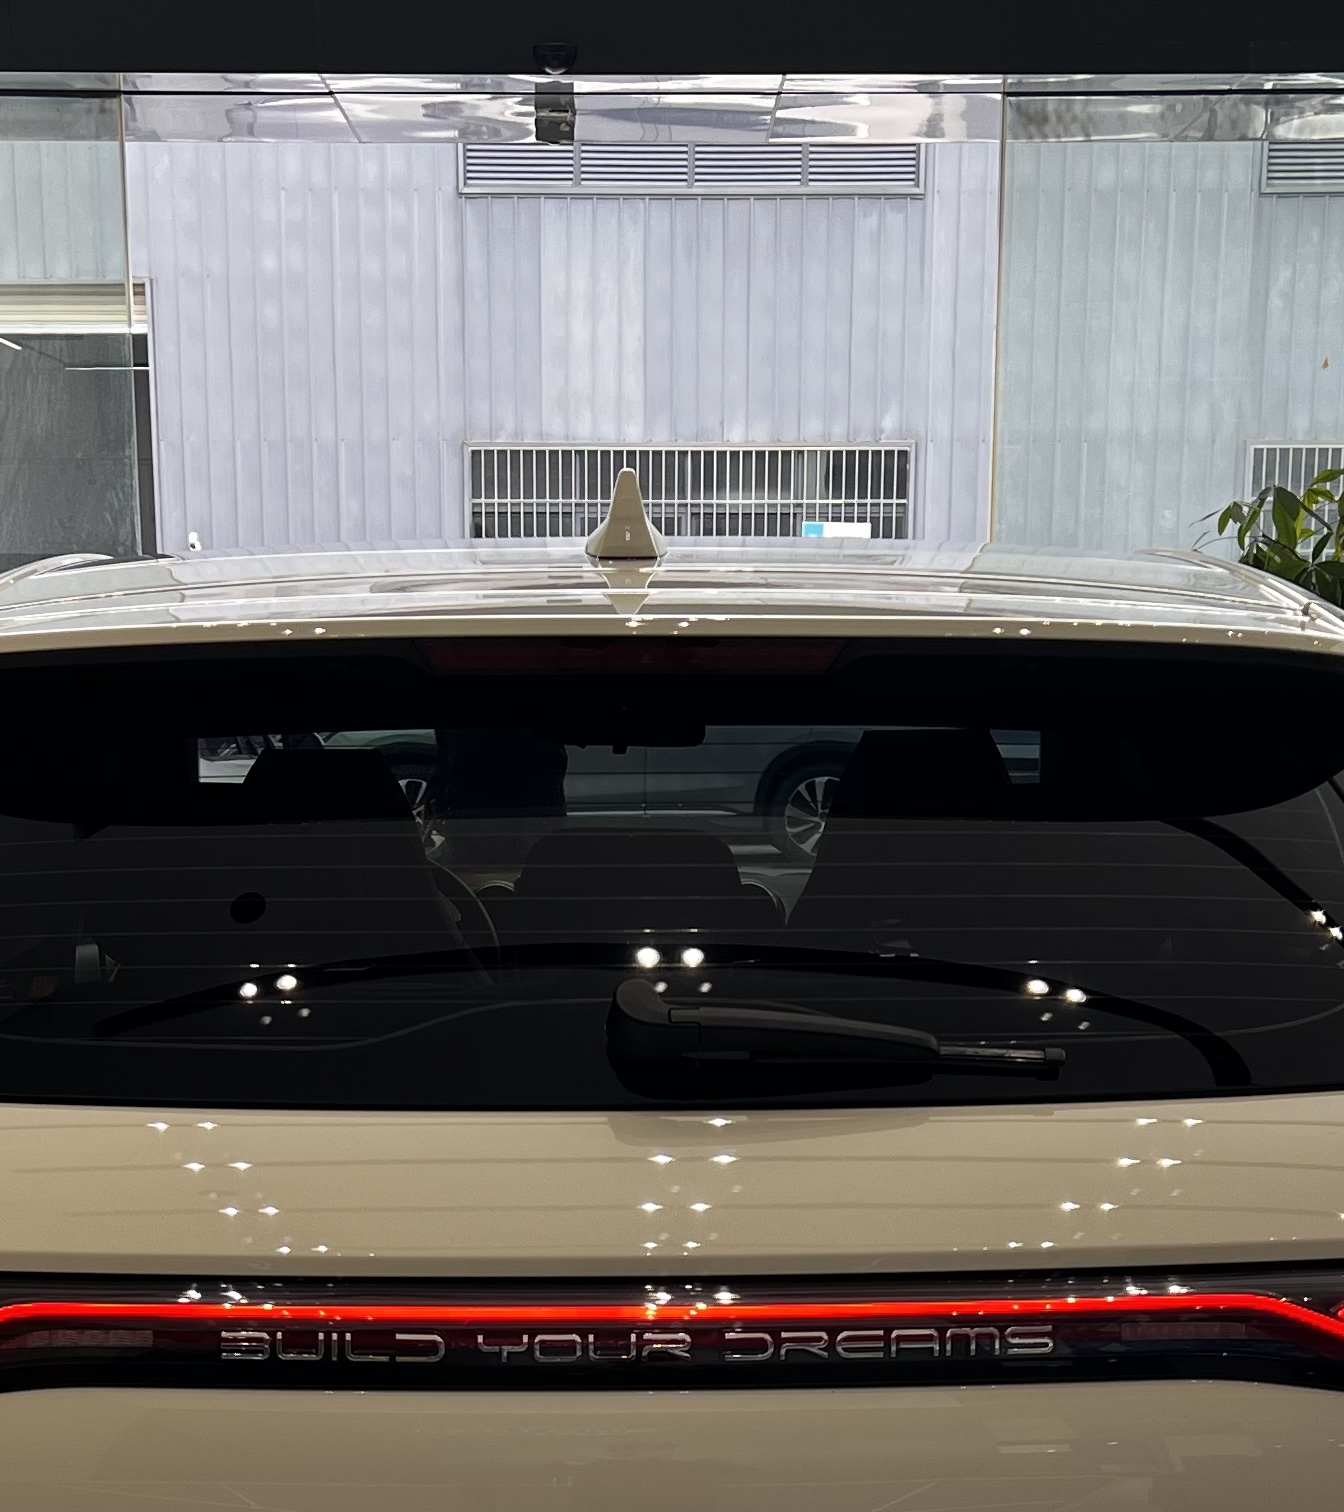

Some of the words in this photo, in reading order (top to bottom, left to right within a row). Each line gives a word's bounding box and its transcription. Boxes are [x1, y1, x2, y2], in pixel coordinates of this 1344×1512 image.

[219, 1329, 446, 1364] BUILD
[477, 1330, 692, 1364] YOUR
[723, 1325, 1055, 1360] DREAMS
